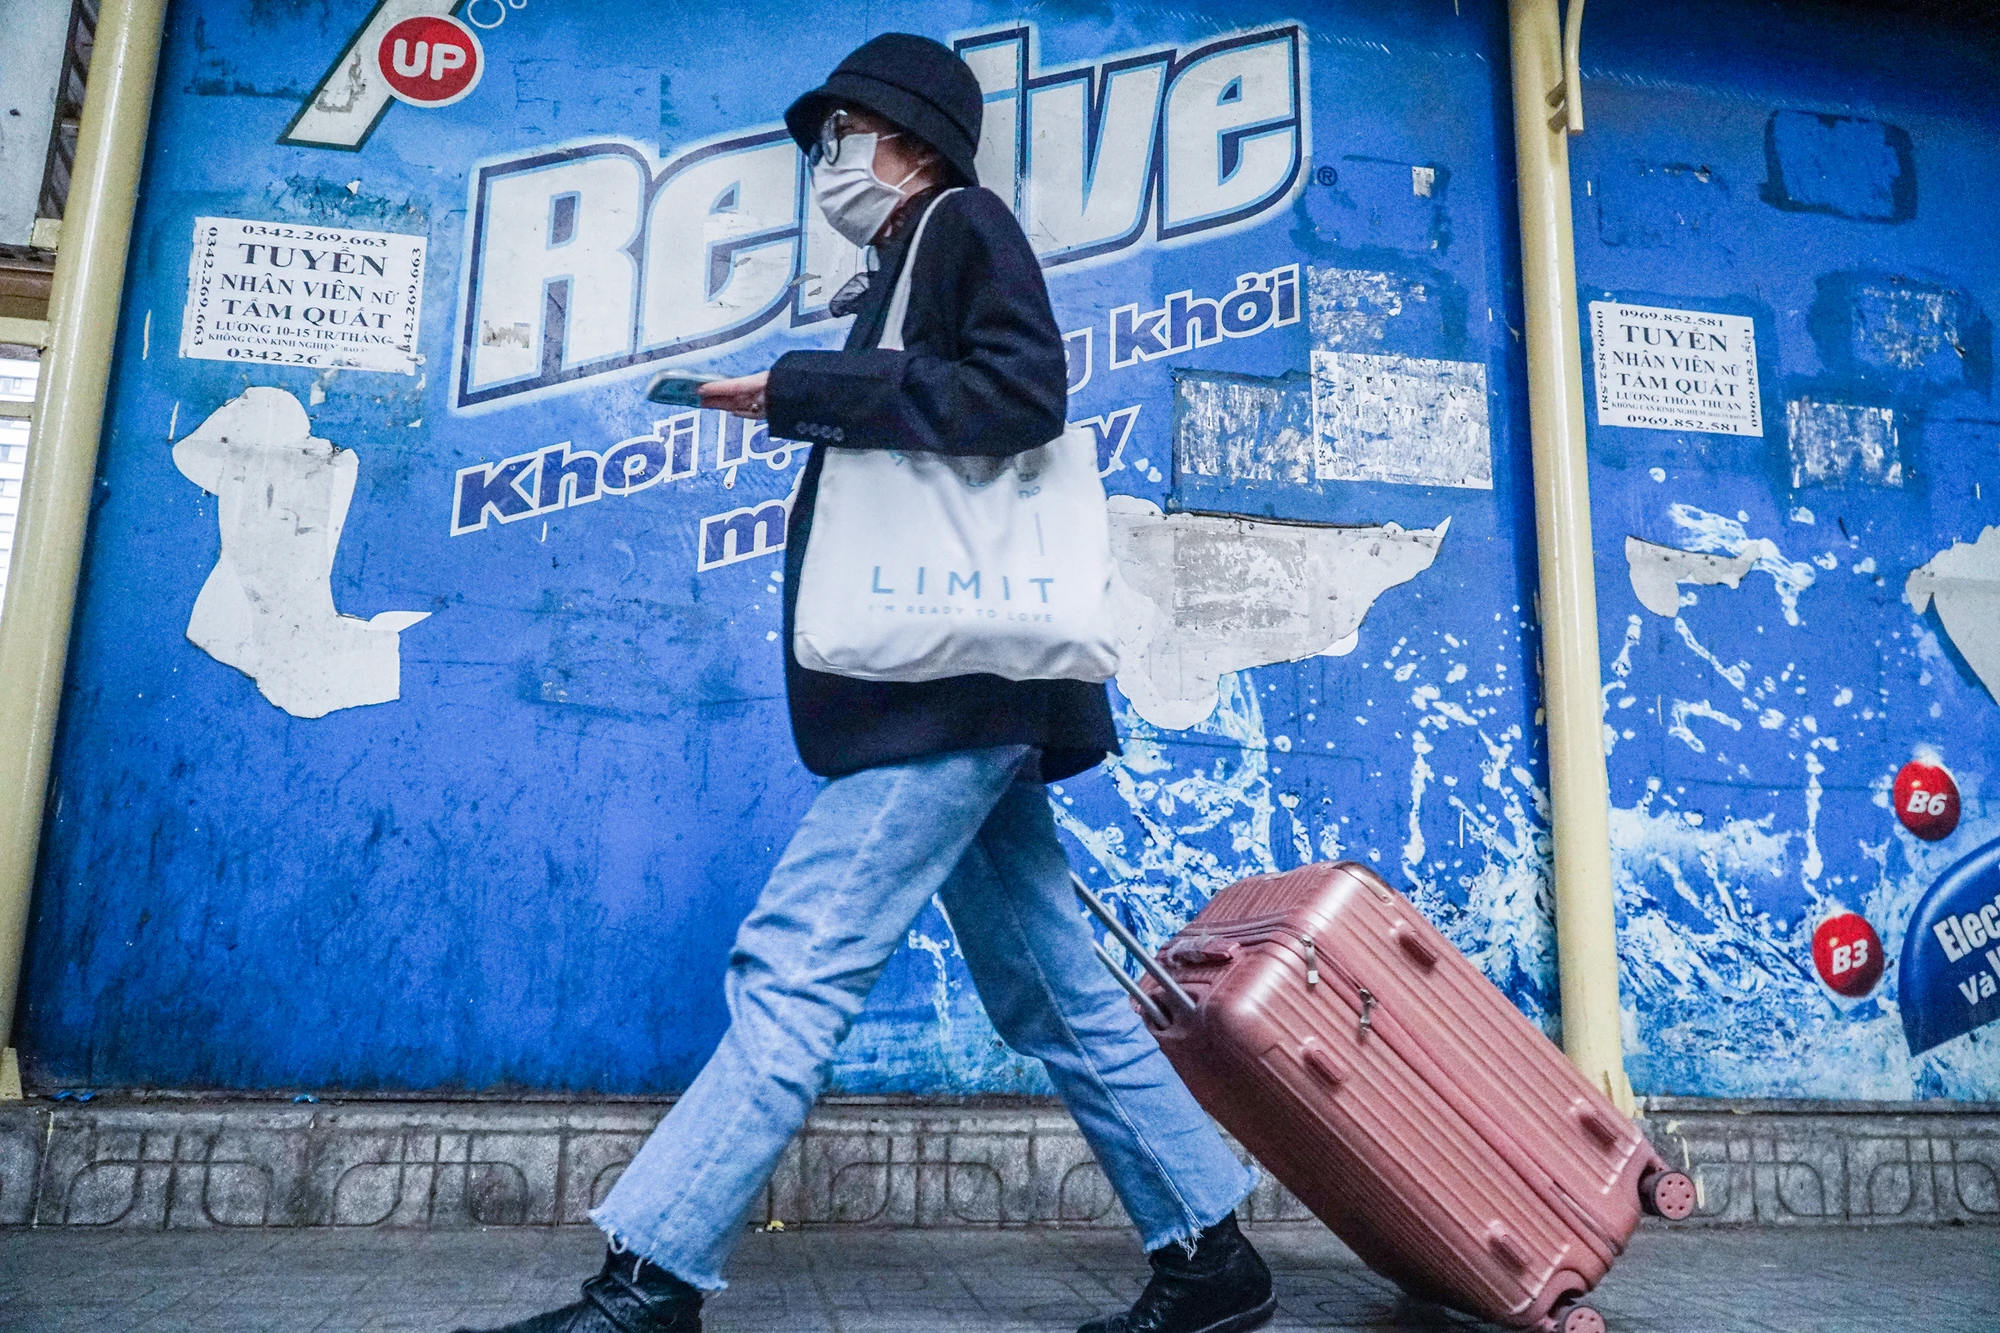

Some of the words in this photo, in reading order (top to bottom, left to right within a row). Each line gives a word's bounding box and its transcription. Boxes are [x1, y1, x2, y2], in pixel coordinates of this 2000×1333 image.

[457, 25, 1301, 407] Reive
[242, 225, 388, 247] 0342.269.663
[193, 226, 218, 347] 0342.269.663
[220, 272, 295, 296] NHÂN
[303, 279, 365, 302] VIÊN
[215, 320, 272, 336] LƯƠNG
[276, 325, 311, 338] 10-15
[1109, 263, 1300, 370] khởi
[1619, 309, 1724, 328] 0969.852.581
[208, 332, 246, 344] KHÔNG
[270, 338, 297, 348] KINH
[1612, 350, 1666, 369] NHÂN
[1671, 354, 1716, 374] VIÊN
[1616, 391, 1660, 404] LƯƠNG
[1626, 414, 1740, 433] 0969.852.581
[871, 566, 1054, 603] LIMIT
[906, 604, 965, 615] READY
[976, 608, 998, 619] TO
[1007, 611, 1053, 623] LOVE
[1907, 790, 1948, 816] B6
[1932, 894, 2000, 963] Elec
[1832, 939, 1869, 976] B3
[1958, 970, 1998, 1006] Và
